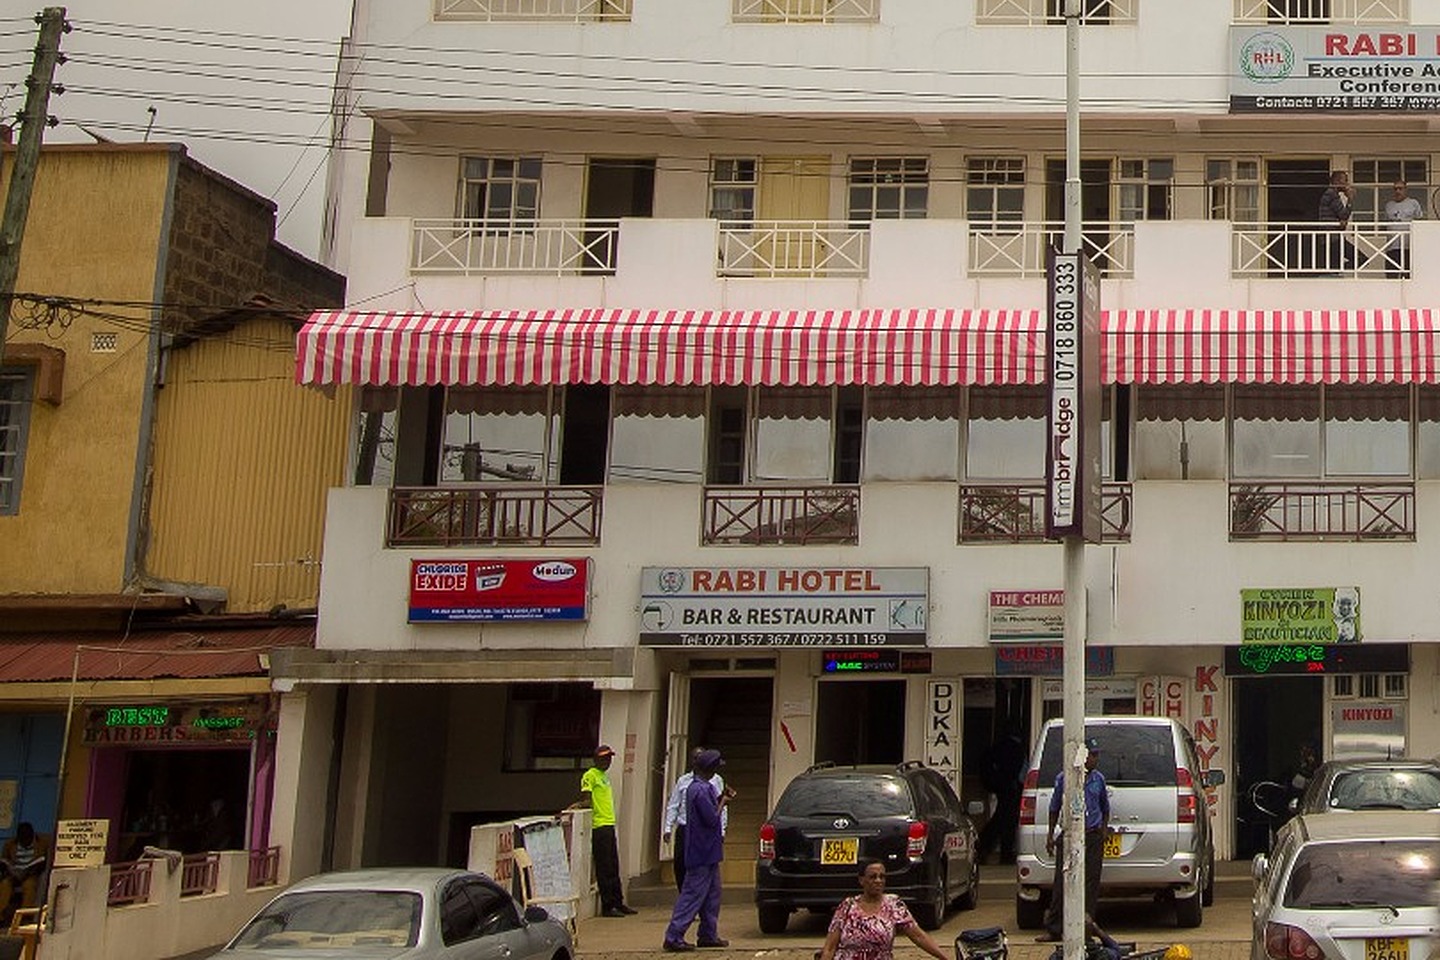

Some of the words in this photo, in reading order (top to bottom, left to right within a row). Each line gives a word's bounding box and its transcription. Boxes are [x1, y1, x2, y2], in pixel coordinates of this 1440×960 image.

[1325, 34, 1416, 56] RABI
[1307, 63, 1414, 78] Executive
[1255, 97, 1313, 109] Contact:
[1316, 97, 1348, 109] 0721
[1055, 261, 1075, 294] 333
[1055, 300, 1075, 332] 860
[1055, 339, 1075, 381] 0718
[416, 574, 467, 590] EXIDE
[692, 570, 767, 592] RABI
[777, 570, 882, 592] HOTEL
[995, 593, 1019, 605] THE
[682, 608, 723, 625] BAR
[727, 608, 743, 625] &
[747, 607, 876, 625] RESTAURANT
[1243, 600, 1325, 621] KINYOZI
[704, 634, 736, 645] 0721
[740, 634, 764, 645] 557
[767, 634, 791, 645] 367
[800, 634, 833, 645] 0722
[835, 634, 859, 645] 511
[863, 634, 887, 645] 159
[106, 707, 168, 727] BEST
[933, 683, 953, 747] DUKA
[1343, 707, 1393, 721] KINYOZI
[85, 727, 187, 742] BARBERS
